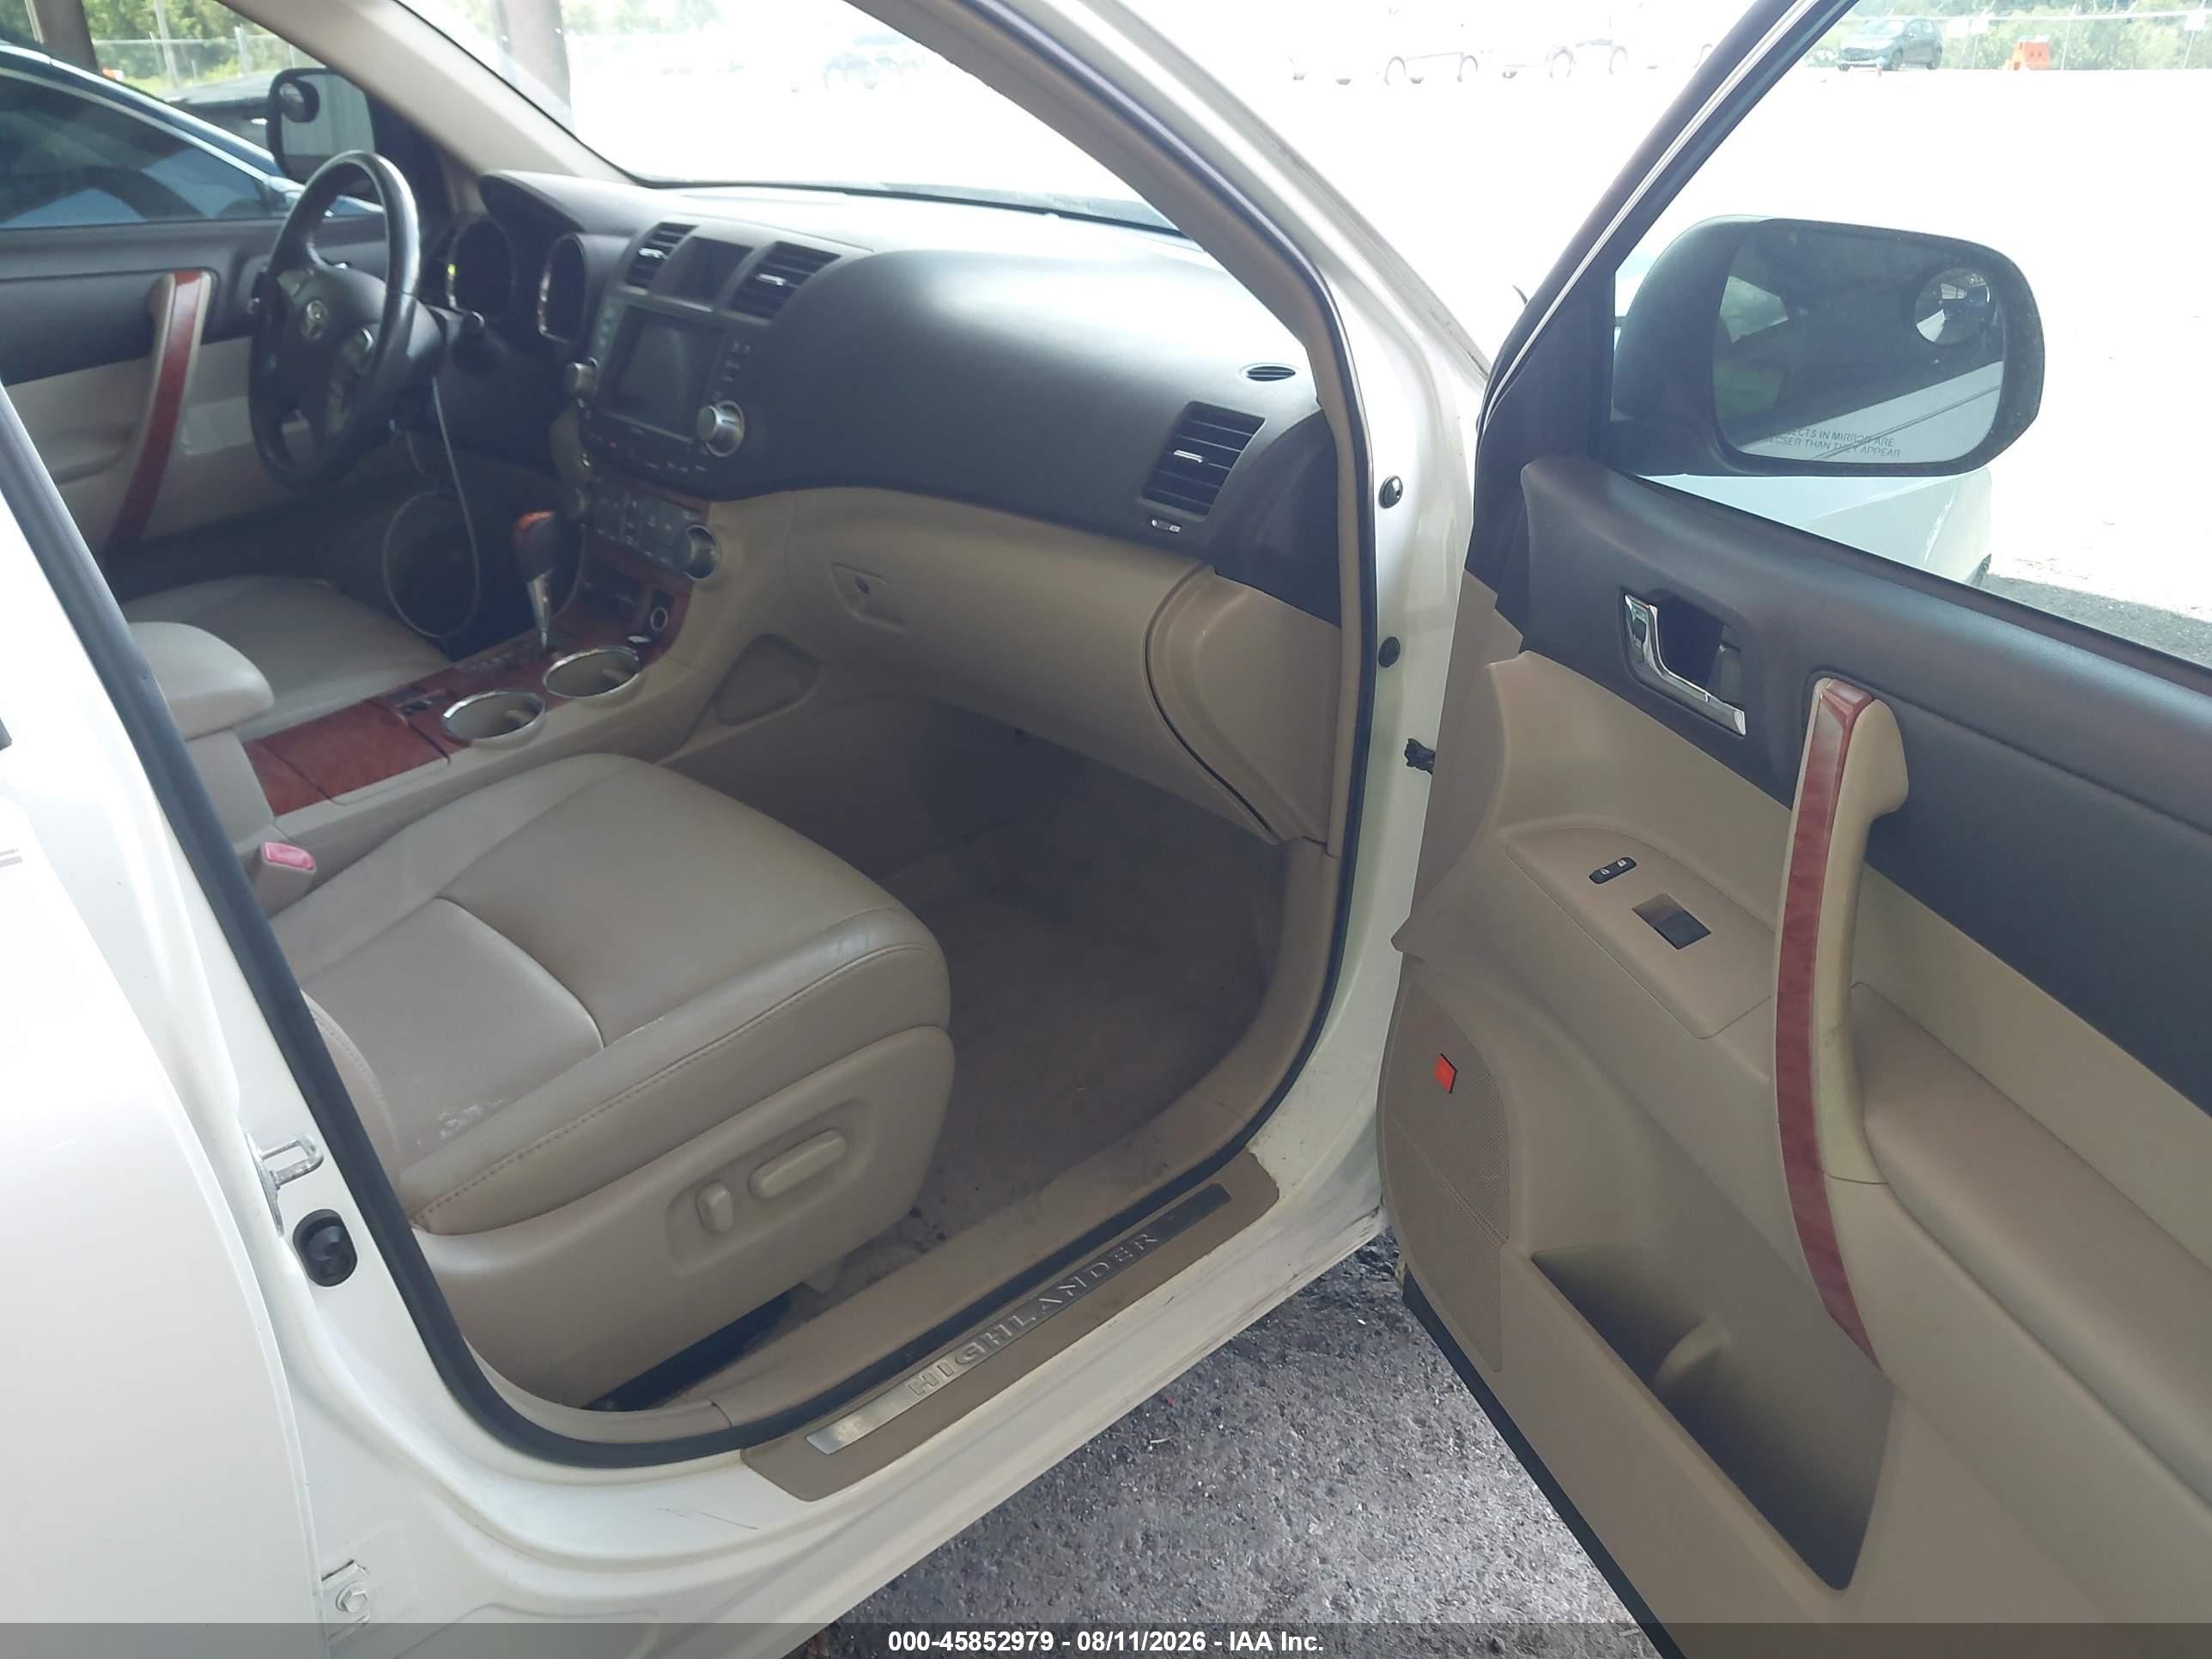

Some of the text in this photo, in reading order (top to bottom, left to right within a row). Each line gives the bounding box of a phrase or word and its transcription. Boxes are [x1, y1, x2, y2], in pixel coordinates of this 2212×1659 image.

[1819, 429, 1830, 440] IN
[1874, 436, 1894, 447] ARE
[1805, 439, 1831, 450] THAN
[1860, 446, 1901, 458] APPEAR
[906, 1233, 1158, 1397] HIGHLANDER
